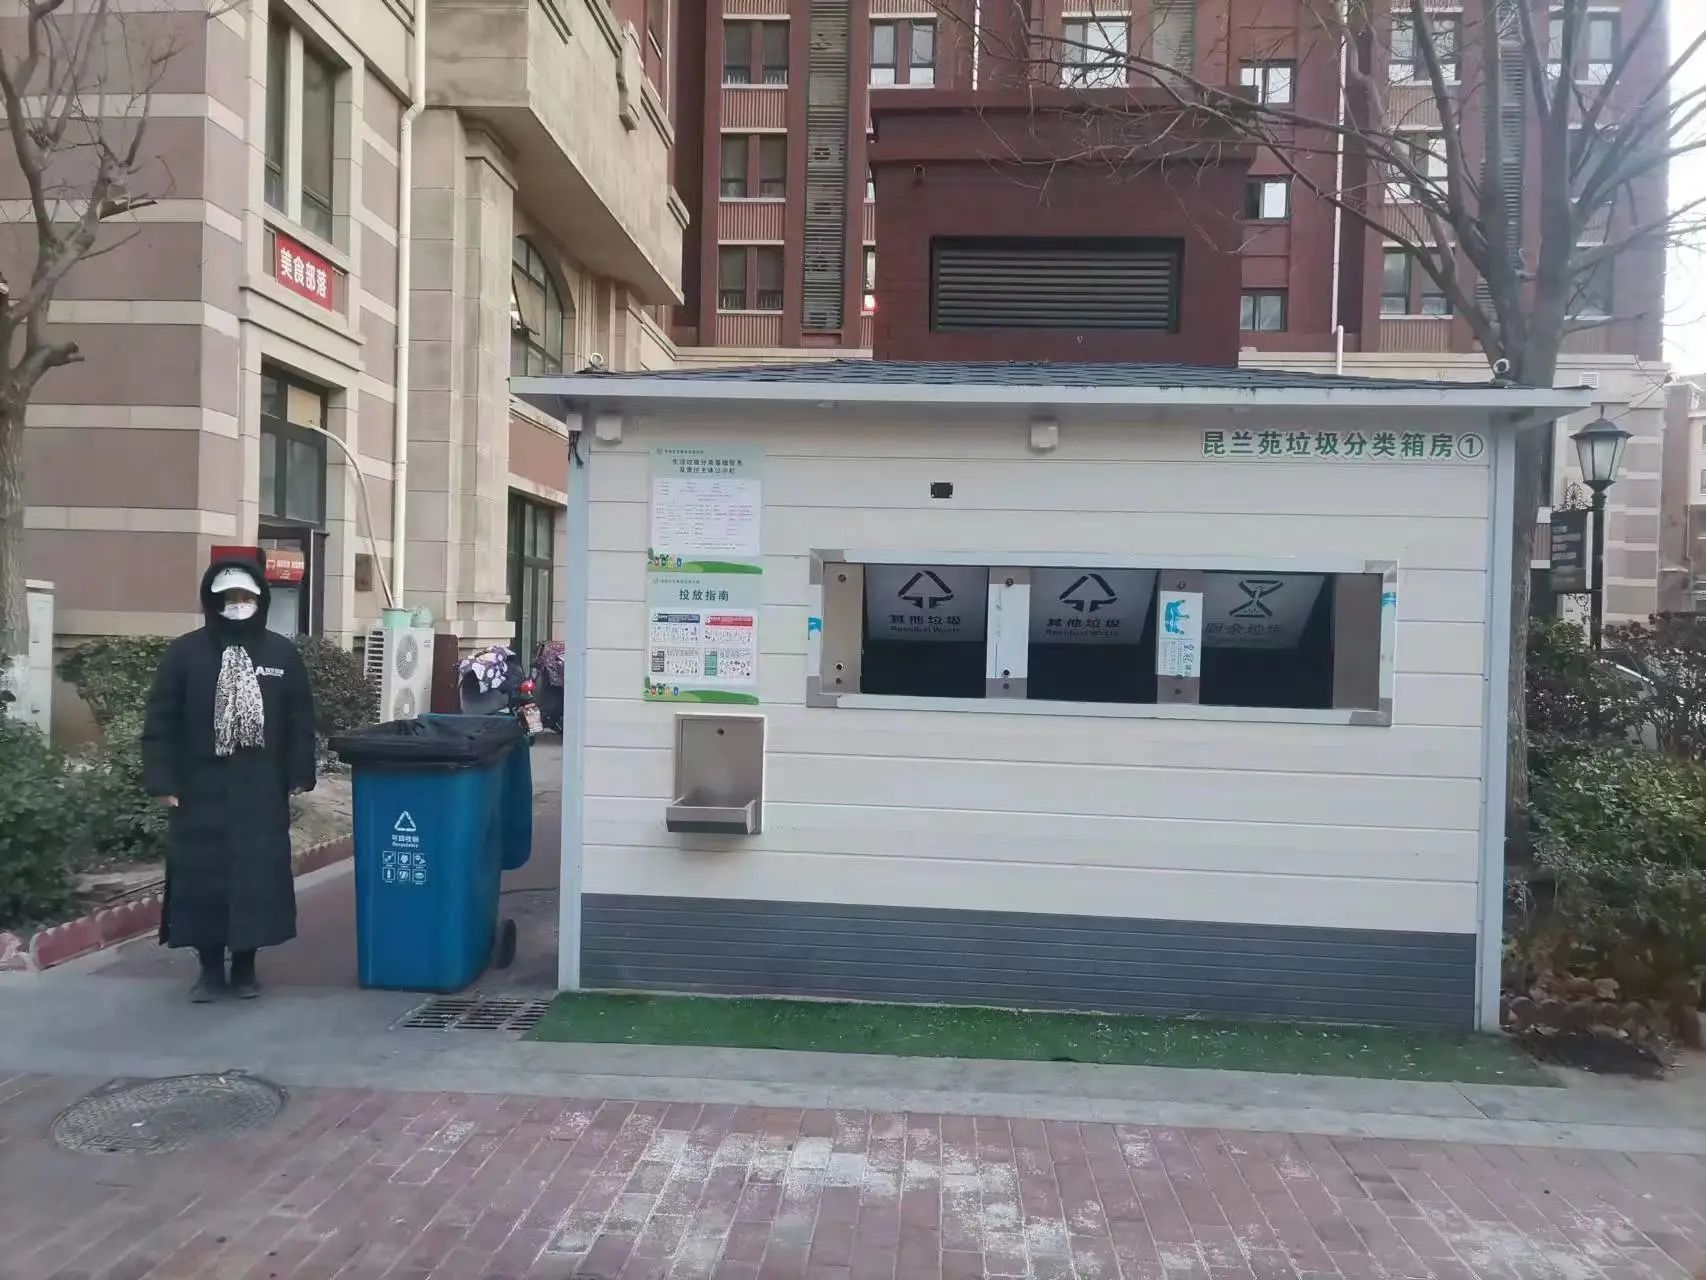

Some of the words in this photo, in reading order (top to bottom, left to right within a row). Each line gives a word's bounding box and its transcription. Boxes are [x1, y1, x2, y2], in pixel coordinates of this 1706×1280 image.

[280, 246, 328, 298] 美食部落
[1203, 430, 1485, 459] 昆兰苑垃圾分类箱房①
[679, 588, 729, 602] 投放指南
